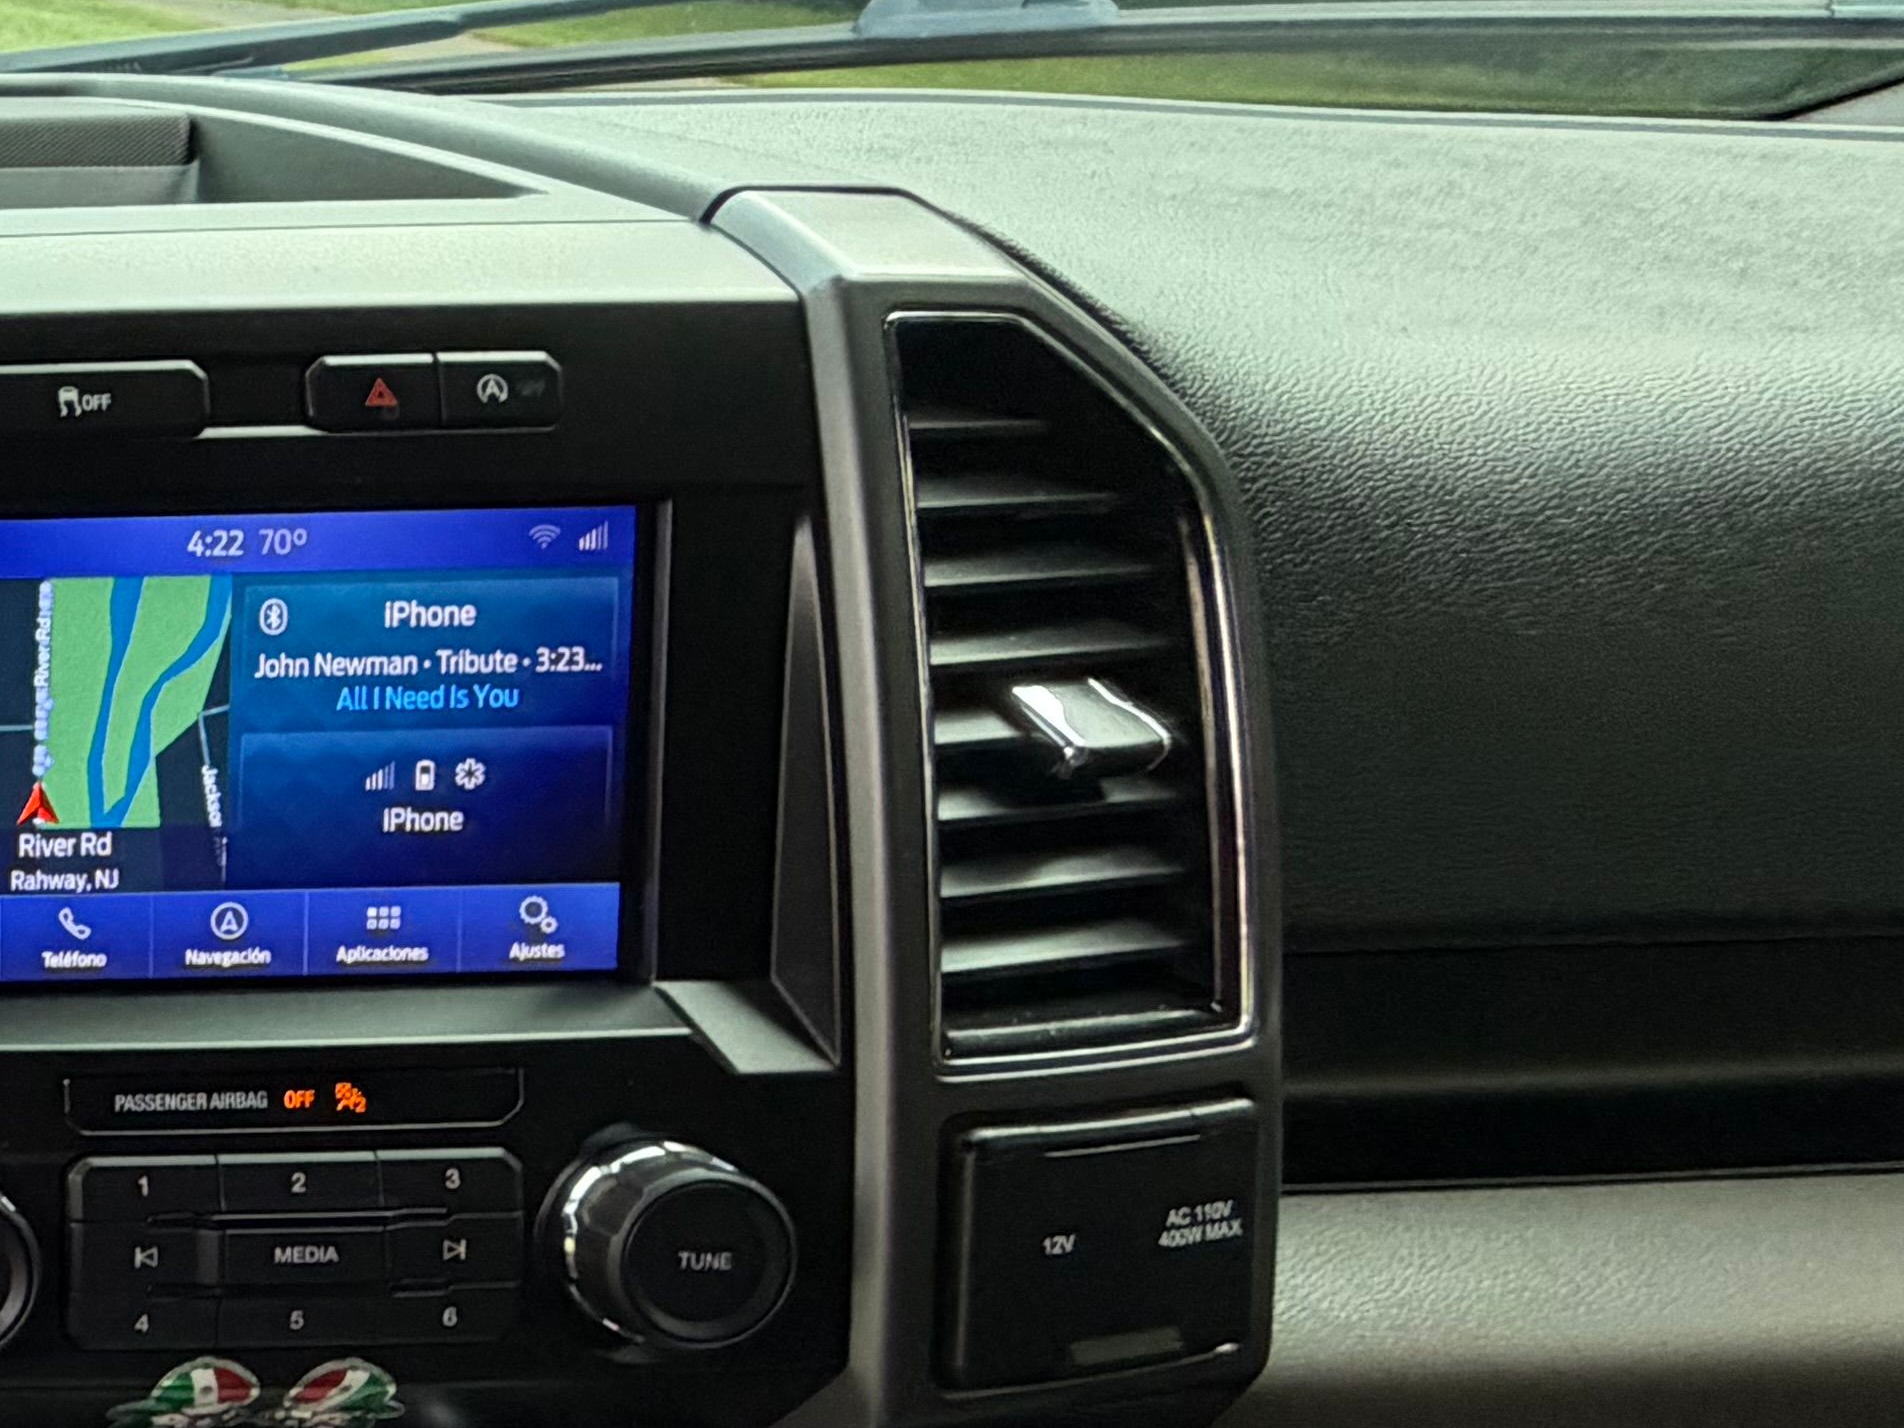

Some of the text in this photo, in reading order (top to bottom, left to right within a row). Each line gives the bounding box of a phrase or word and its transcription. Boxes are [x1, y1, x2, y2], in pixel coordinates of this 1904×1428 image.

[82, 393, 111, 411] OFF
[187, 529, 245, 558] 4:22
[384, 600, 477, 629] iPhone
[33, 645, 52, 687] River
[254, 652, 310, 679] John
[314, 651, 419, 677] Newman
[435, 648, 518, 674] Tribute
[336, 685, 367, 711] All
[388, 684, 445, 710] Need
[449, 684, 469, 710] Is
[473, 683, 520, 709] You
[17, 831, 113, 859] River Rd
[10, 867, 120, 894] Rahway, NJ
[41, 950, 108, 969] Teléfono
[185, 946, 272, 968] Navegación
[335, 943, 430, 965] Aplicaciones
[509, 940, 565, 960] Ajustes
[114, 1088, 315, 1112] PASSENGER AIRBAG OFF
[137, 1168, 461, 1196] 1 2 3
[1166, 1207, 1191, 1227] AC
[1205, 1218, 1243, 1241] MAX
[274, 1245, 339, 1265] MEDIA
[1042, 1233, 1076, 1255] 12V
[677, 1251, 733, 1271] TUNE
[134, 1306, 458, 1333] 4 5 6
